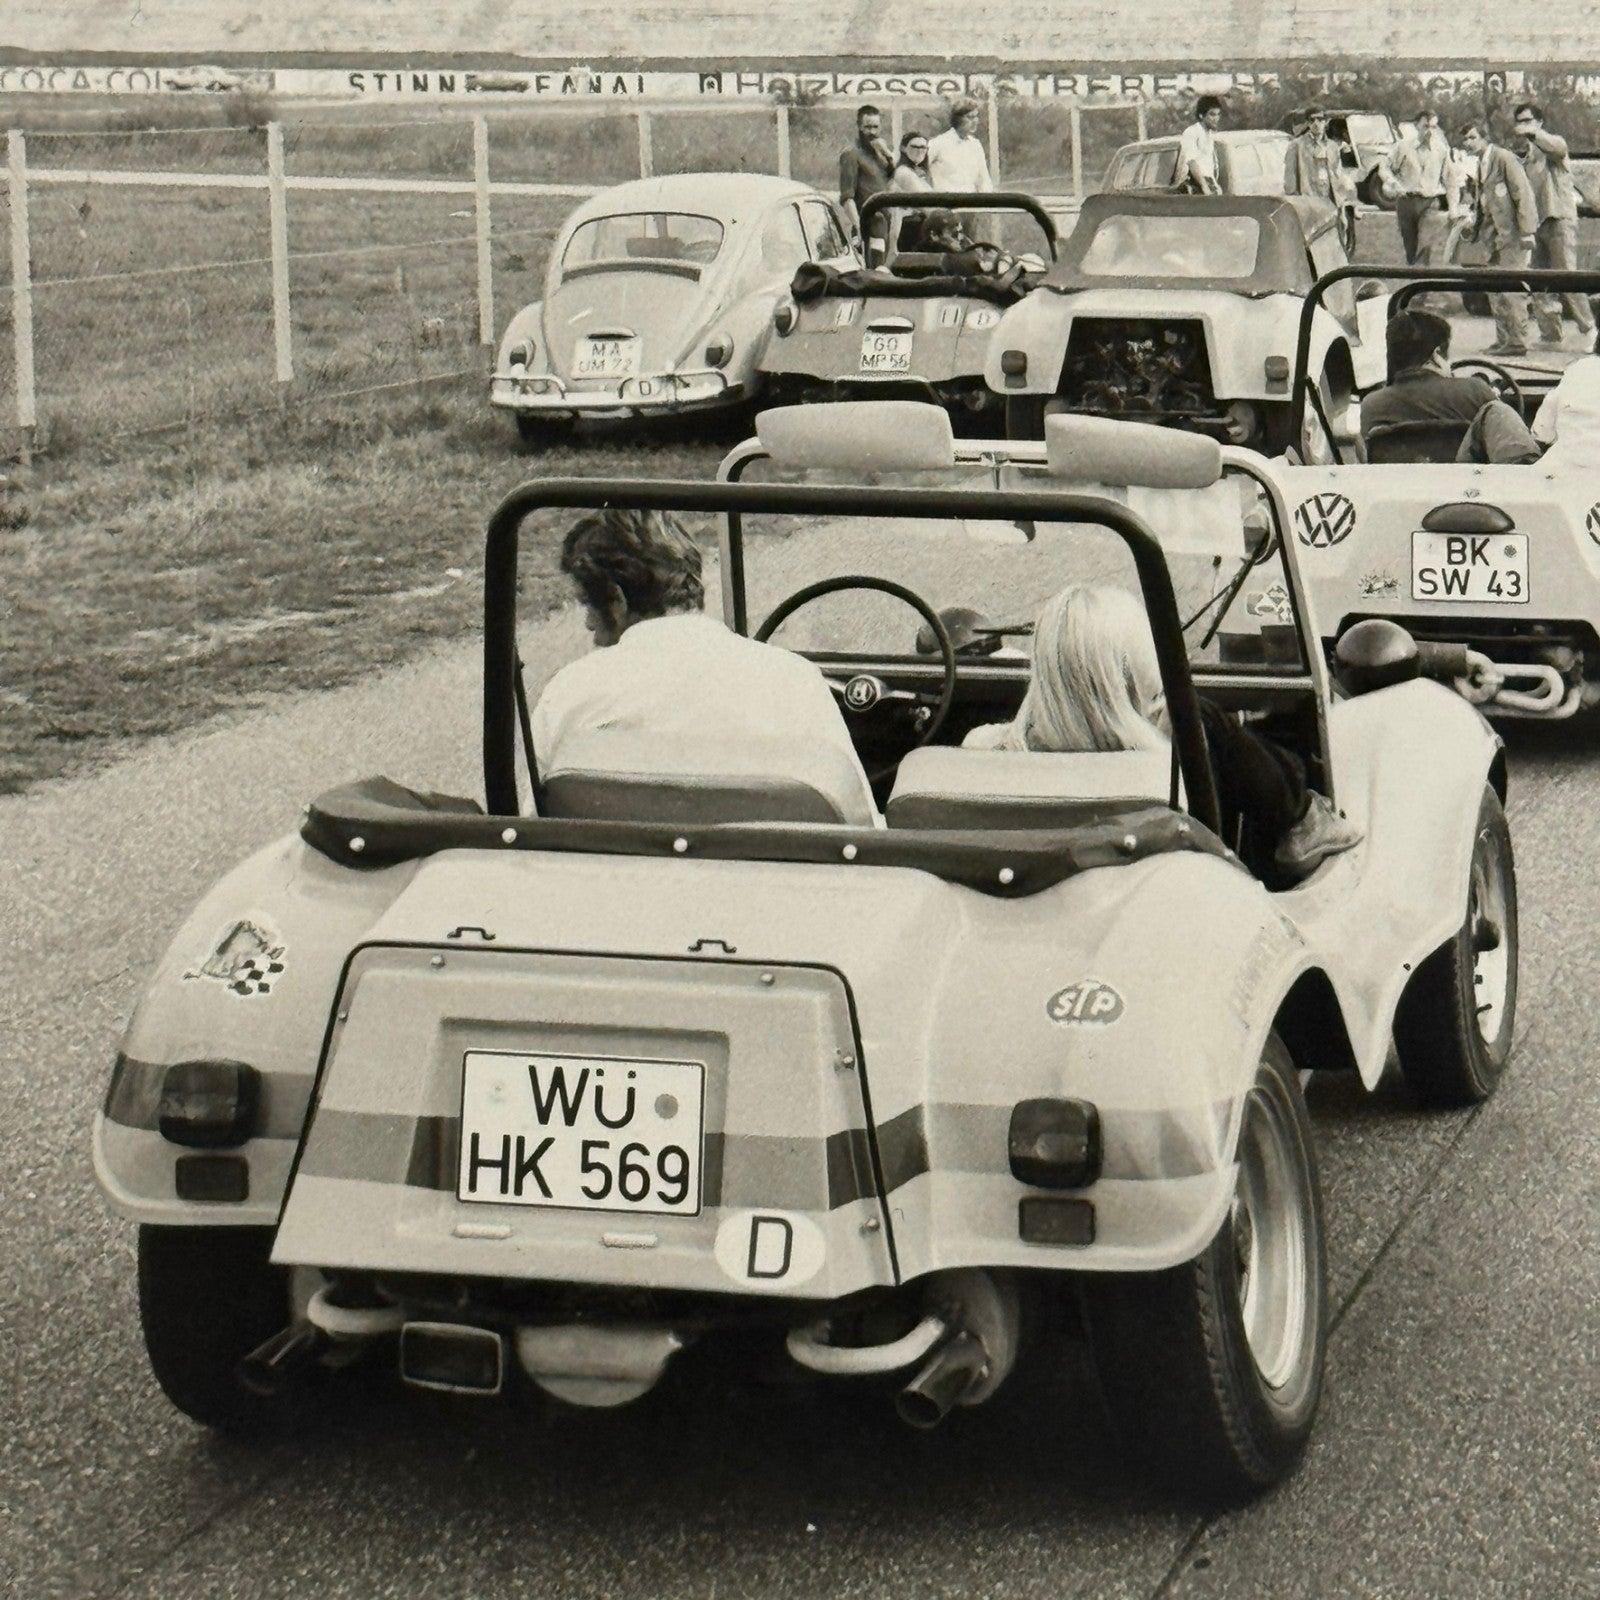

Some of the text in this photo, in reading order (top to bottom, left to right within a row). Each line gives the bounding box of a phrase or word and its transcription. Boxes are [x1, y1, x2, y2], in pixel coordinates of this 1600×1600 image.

[1446, 536, 1490, 566] BK
[1418, 567, 1522, 597] SW 43
[1053, 981, 1116, 1017] STP
[528, 1064, 636, 1129] WÜ
[467, 1132, 690, 1205] HK 569
[747, 1216, 793, 1279] D
